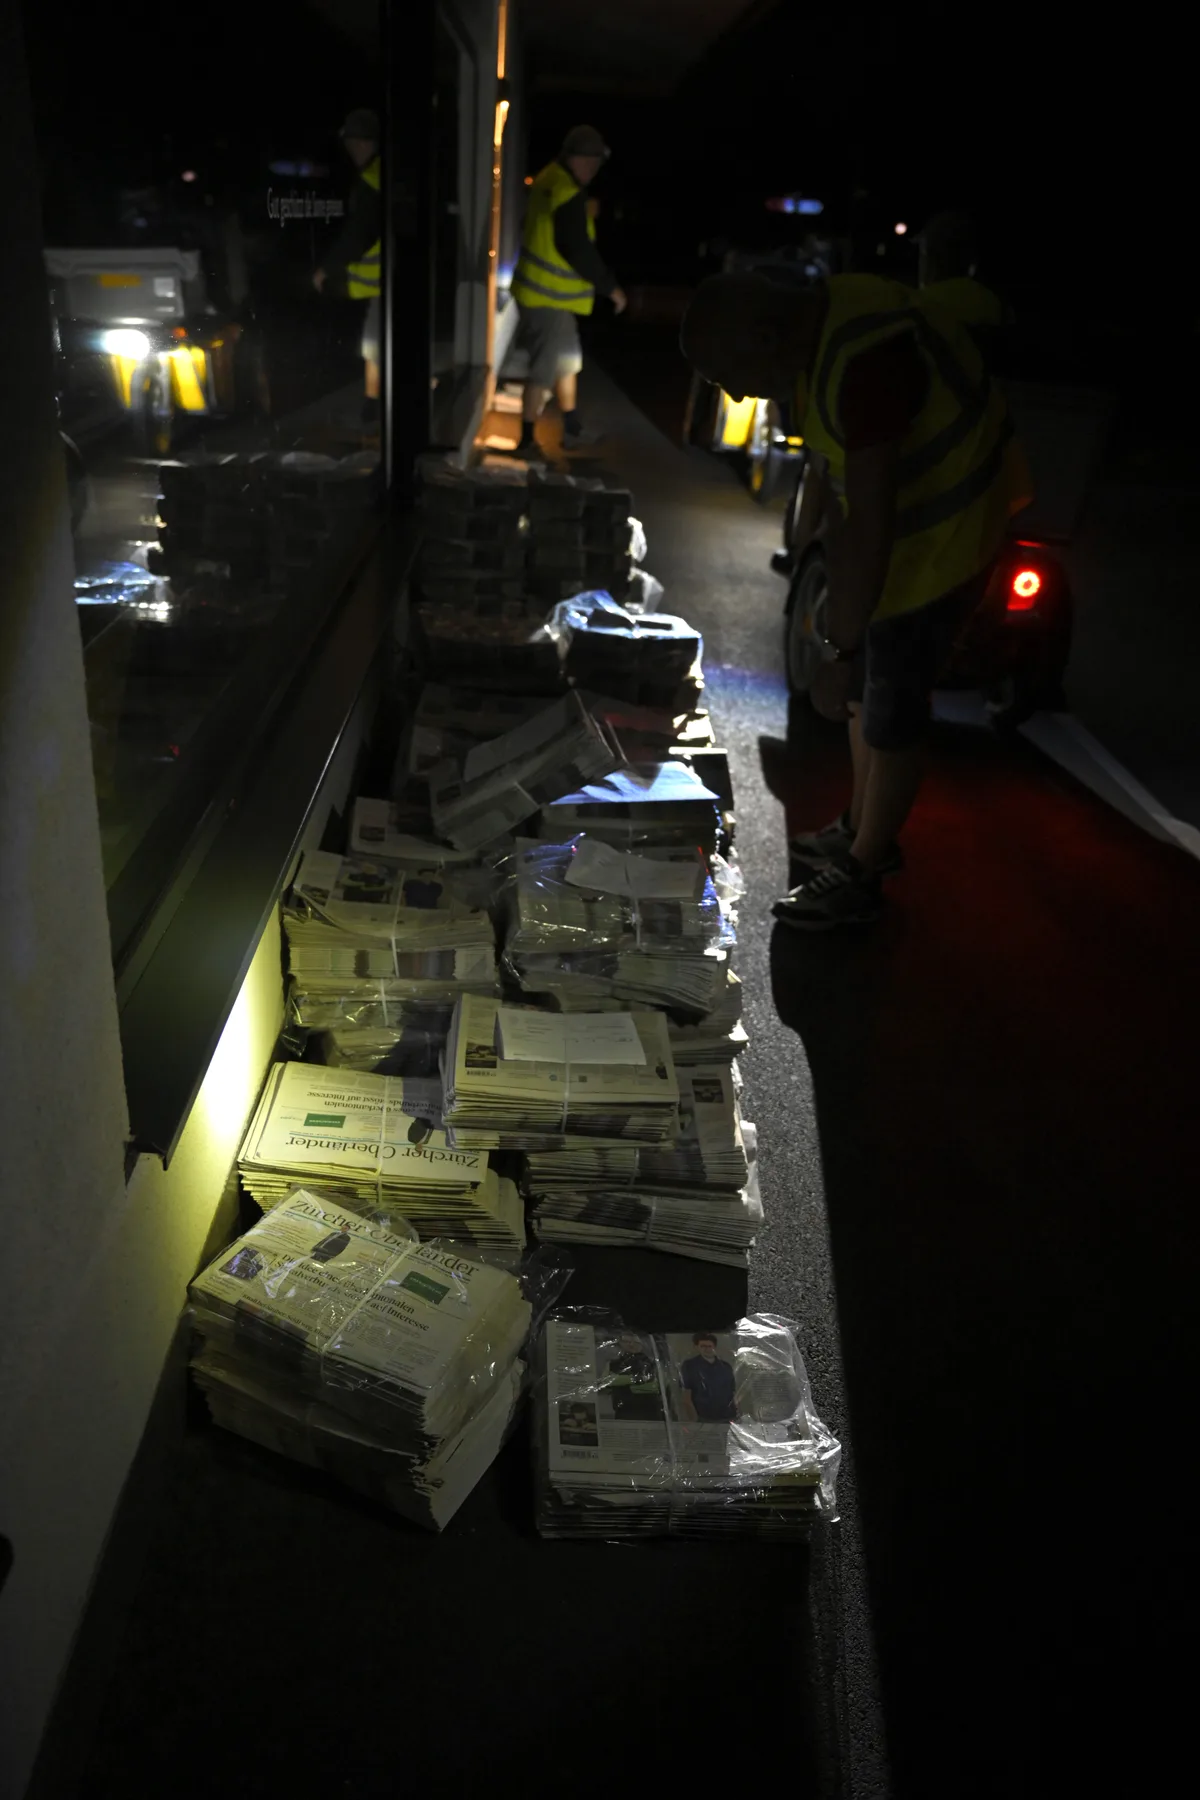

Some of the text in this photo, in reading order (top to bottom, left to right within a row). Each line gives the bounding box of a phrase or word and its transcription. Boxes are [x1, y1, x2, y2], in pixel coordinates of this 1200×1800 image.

[307, 1091, 345, 1101] Interesse
[347, 1094, 360, 1102] auf
[286, 1137, 480, 1169] Zürcher Oberländer
[290, 1200, 367, 1232] Zürcher
[370, 1229, 479, 1277] Obeländer
[298, 1262, 318, 1274] Idee
[370, 1302, 388, 1313] auf
[387, 1306, 430, 1332] Interesse
